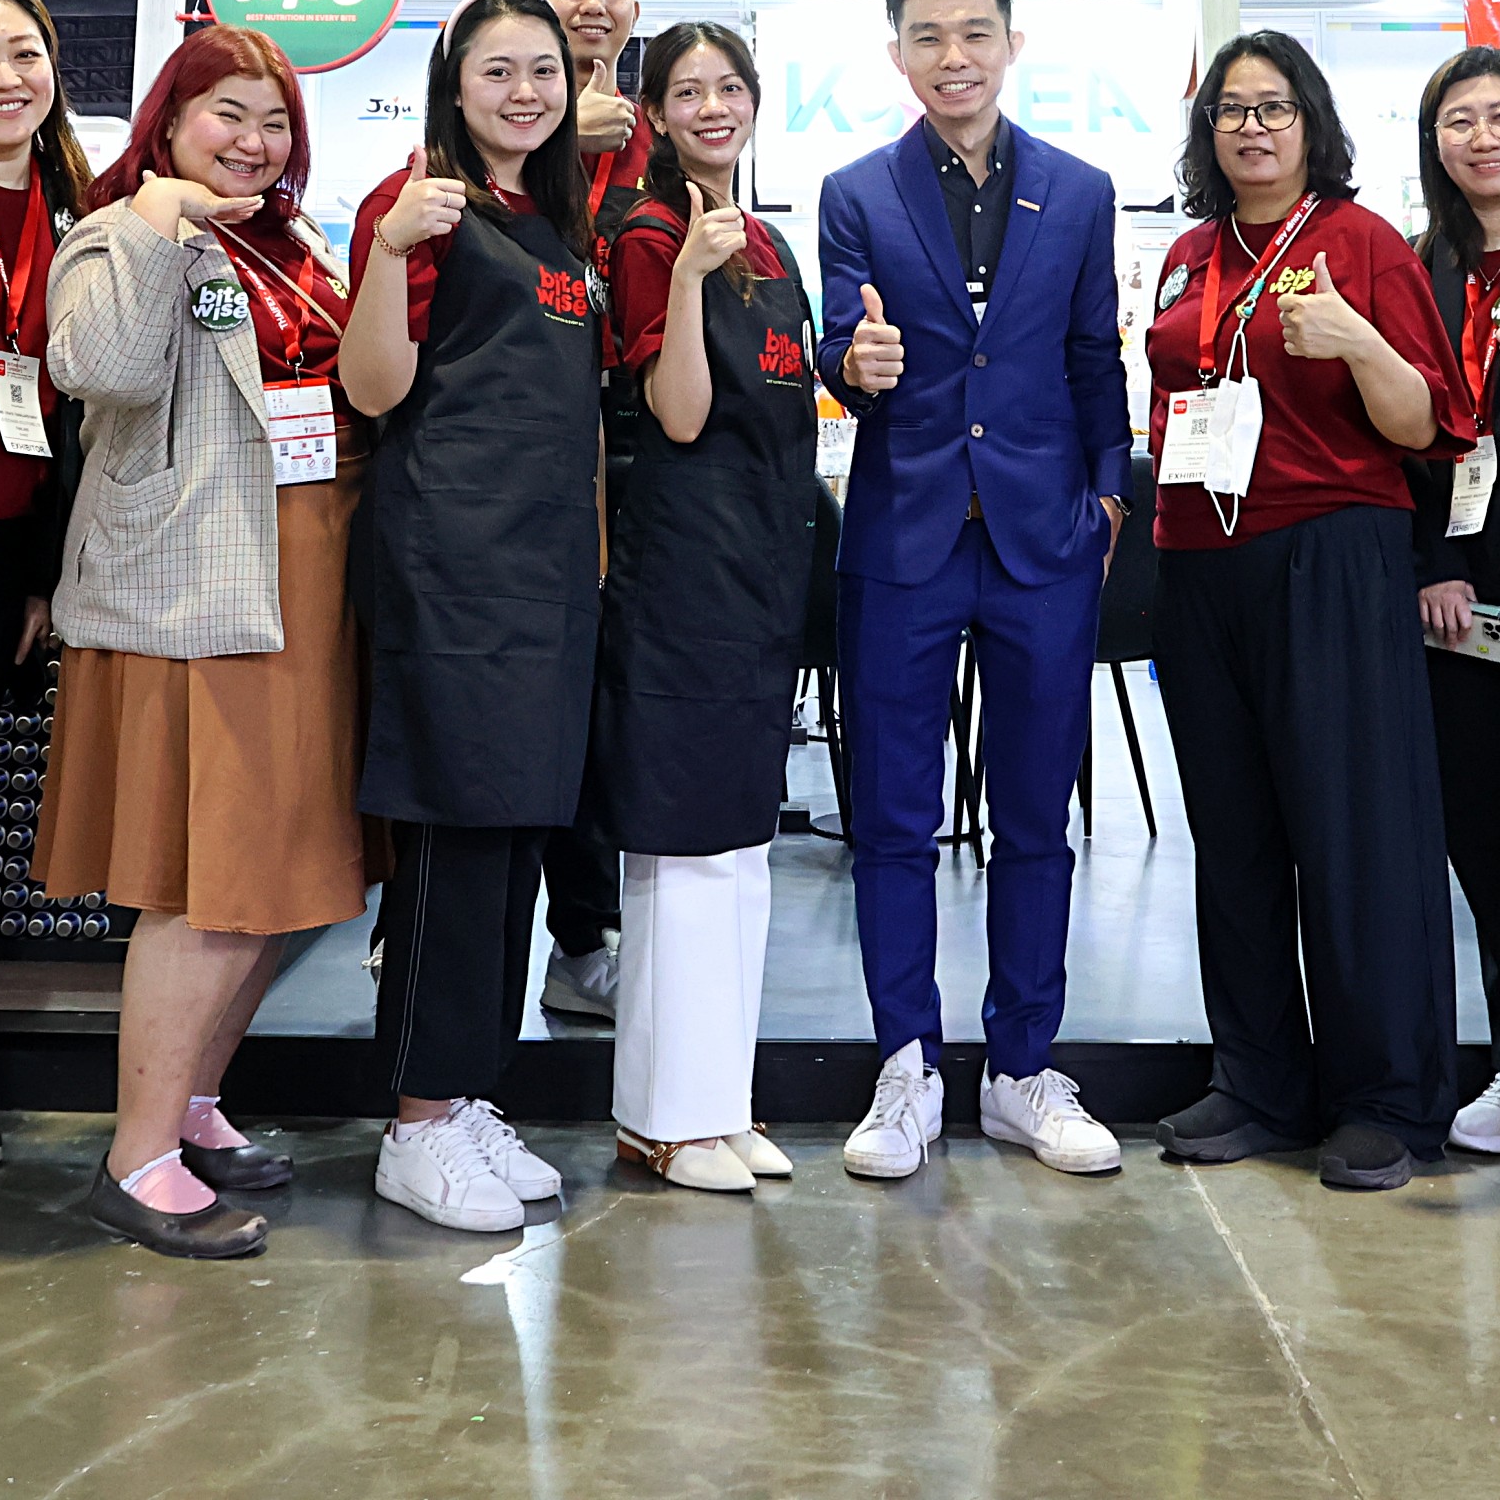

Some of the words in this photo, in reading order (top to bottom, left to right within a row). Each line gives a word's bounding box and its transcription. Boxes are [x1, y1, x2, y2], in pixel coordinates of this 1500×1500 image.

[245, 13, 264, 21] BEST
[265, 13, 305, 21] NUTRITION
[315, 14, 339, 22] EVERY
[341, 14, 357, 22] BITE
[366, 98, 412, 121] Jeju
[1286, 212, 1303, 233] Anuga
[538, 264, 586, 298] bite
[199, 285, 250, 307] bite
[535, 285, 588, 317] wise
[192, 303, 249, 321] wise
[263, 295, 289, 331] THAIFEX
[765, 327, 801, 360] bite
[758, 353, 803, 378] wise
[10, 442, 46, 454] EXHIBITOR
